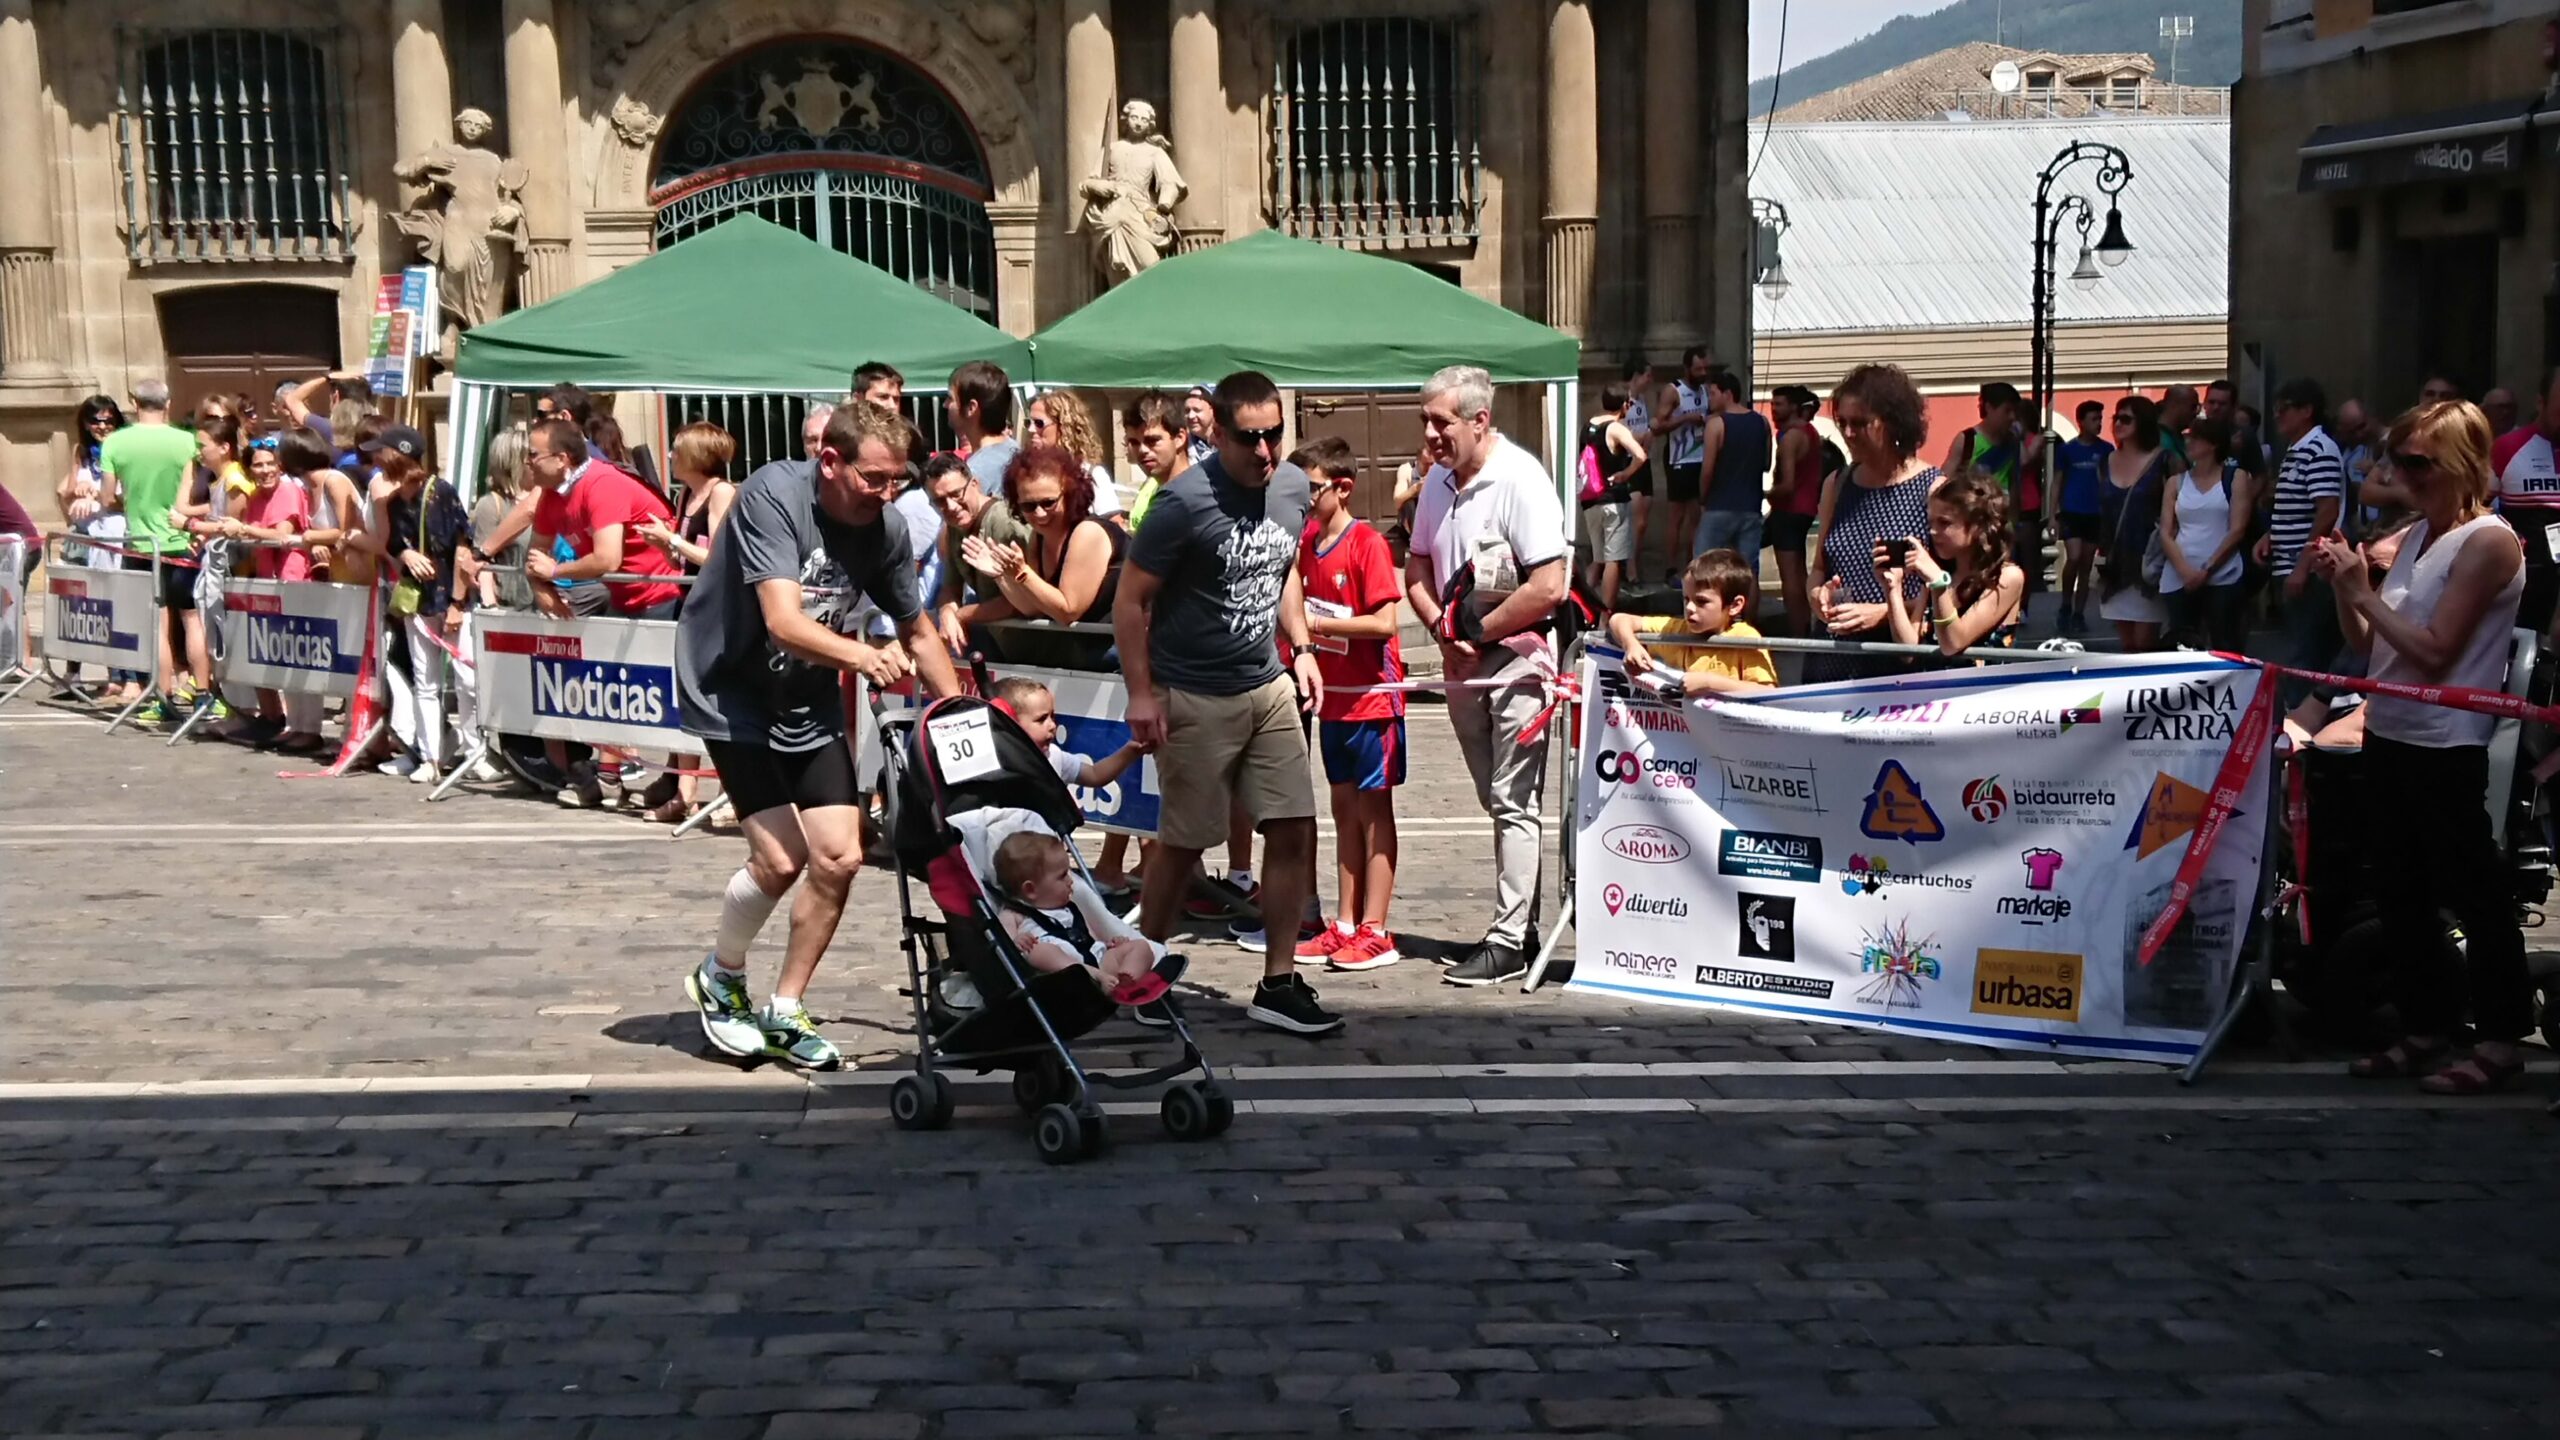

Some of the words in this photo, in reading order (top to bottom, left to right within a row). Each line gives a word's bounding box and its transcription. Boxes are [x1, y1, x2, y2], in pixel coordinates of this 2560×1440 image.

[59, 598, 110, 644] Noticias
[816, 608, 842, 626] 46
[249, 616, 333, 669] Noticias
[536, 637, 566, 656] Diario
[568, 640, 580, 657] de
[536, 661, 664, 724] Noticias
[2125, 679, 2238, 716] IRUÑA
[1626, 708, 1690, 733] YAMAHA
[1963, 709, 2055, 724] LABORAL
[2123, 712, 2236, 740] ZARRA
[2016, 728, 2057, 739] kutxa
[948, 738, 974, 762] 30
[1643, 758, 1697, 776] canal
[1652, 773, 1696, 789] cero
[1727, 766, 1811, 799] LIZARBE
[2013, 788, 2116, 806] bidaurreta
[1615, 838, 1680, 858] AROMA
[1734, 836, 1809, 857] BIANBI
[1840, 866, 1973, 890] merkecartuchos
[1625, 893, 1688, 917] divertis
[1996, 894, 2071, 923] markaje
[1604, 950, 1678, 973] nainere
[1698, 967, 1763, 988] ALBERTO
[1764, 975, 1831, 990] ESTUDIO
[1979, 975, 2073, 1010] urbasa
